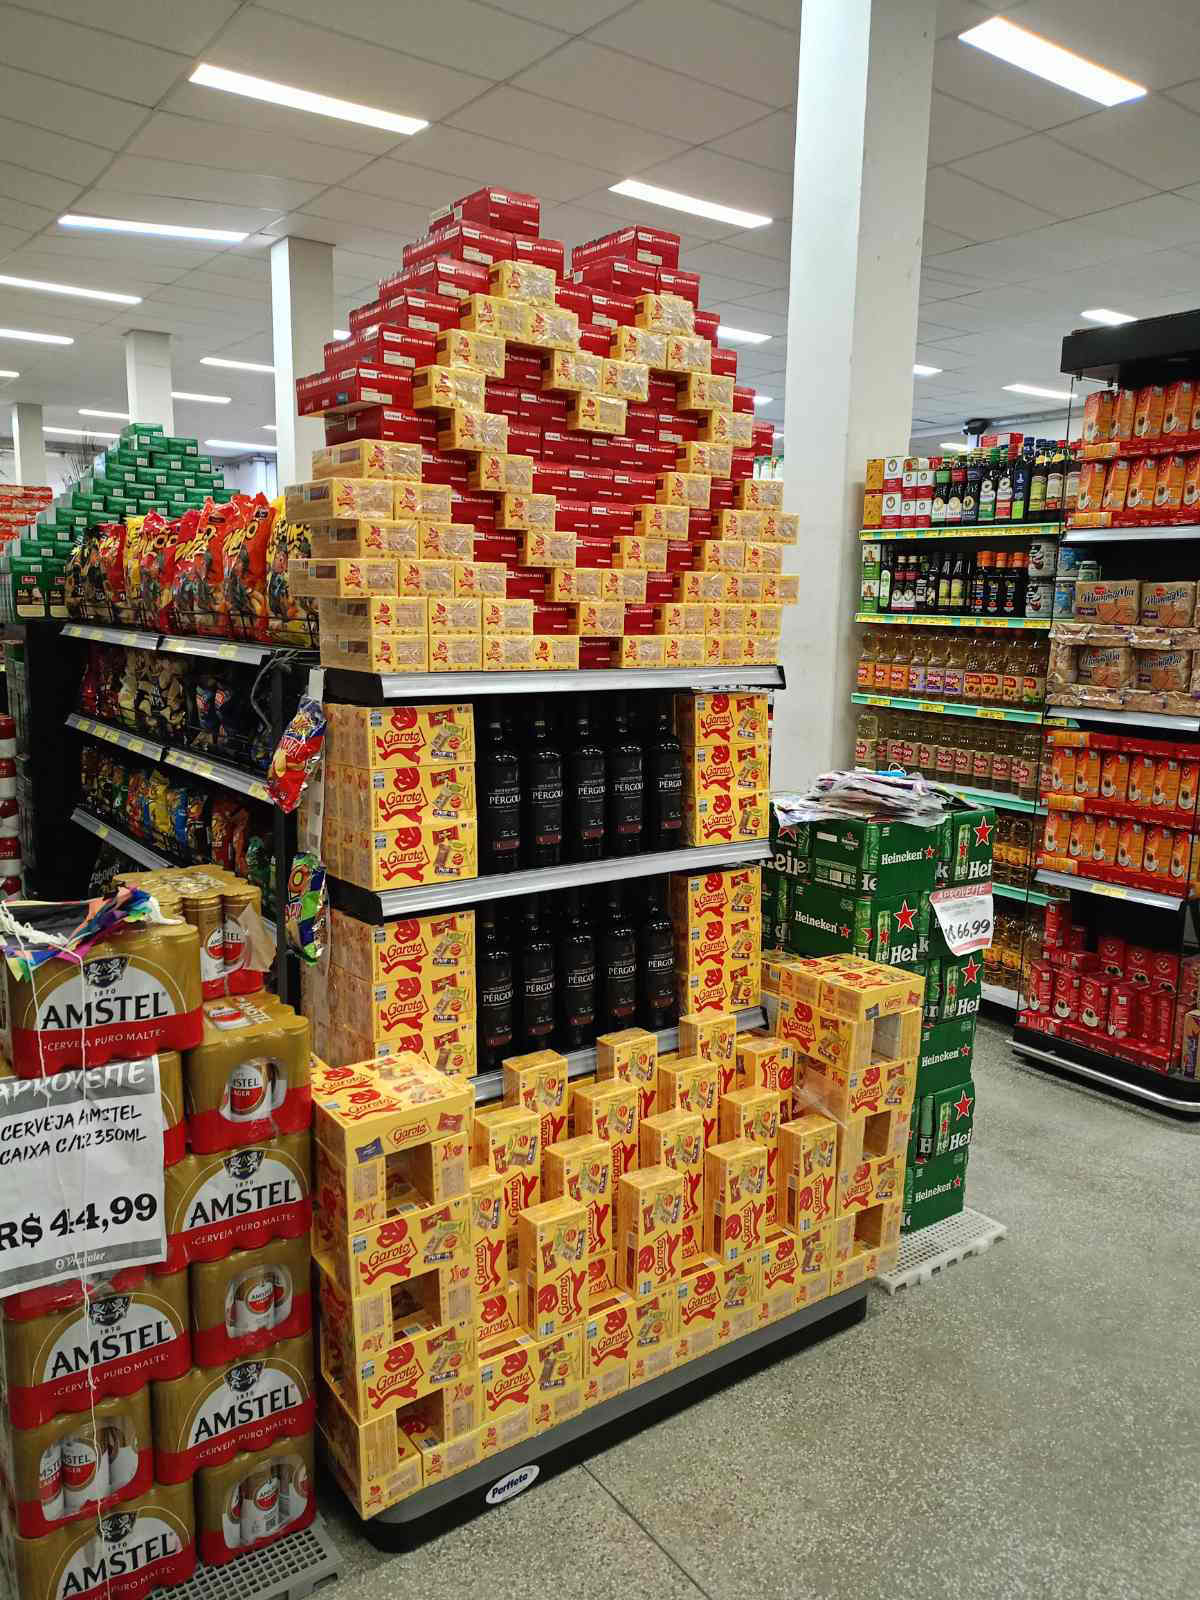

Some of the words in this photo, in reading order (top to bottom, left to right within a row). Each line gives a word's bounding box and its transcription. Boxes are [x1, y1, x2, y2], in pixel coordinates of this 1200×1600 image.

[384, 730, 420, 745] Garoto
[386, 790, 422, 806] Garoto
[387, 849, 424, 865] Garoto
[881, 850, 923, 866] Heineken
[795, 911, 838, 932] Heineken
[957, 919, 990, 940] 66,99
[387, 942, 423, 959] Garoto
[41, 992, 168, 1030] AMSTEL
[388, 1000, 424, 1017] Garoto
[94, 1033, 124, 1047] PURO
[126, 1029, 161, 1042] MALTE
[922, 1049, 959, 1068] Heineken
[2, 1113, 74, 1141] CERVEJA
[78, 1105, 142, 1127] AMSTEL
[393, 1122, 427, 1142] Garoto
[0, 1141, 50, 1165] CAIXA
[95, 1128, 147, 1146] 350ML
[189, 1178, 298, 1229] AMSTEL
[509, 1179, 520, 1218] Garoto
[915, 1181, 951, 1202] Heineken
[0, 1212, 43, 1249] R$
[50, 1192, 157, 1238] 44,99
[194, 1228, 233, 1246] CERVEJA
[234, 1220, 262, 1236] PURO
[262, 1213, 292, 1230] MALTE
[368, 1243, 411, 1267] Garoto
[474, 1245, 486, 1287] Garoto
[768, 1257, 796, 1279] Garoto
[557, 1273, 572, 1317] Garoto
[688, 1290, 718, 1312] Garoto
[52, 1320, 171, 1378] AMSTEL
[597, 1327, 630, 1351] Garoto
[103, 1363, 132, 1384] PURO
[133, 1353, 167, 1374] MALTE
[377, 1365, 418, 1391] Garoto
[493, 1371, 530, 1395] Garoto
[193, 1387, 297, 1446] AMSTEL
[200, 1438, 236, 1459] CERVEJA
[237, 1428, 263, 1446] PURO
[264, 1417, 294, 1436] MALTE
[63, 1533, 178, 1597] AMSTEL
[139, 1565, 172, 1586] MALTE
